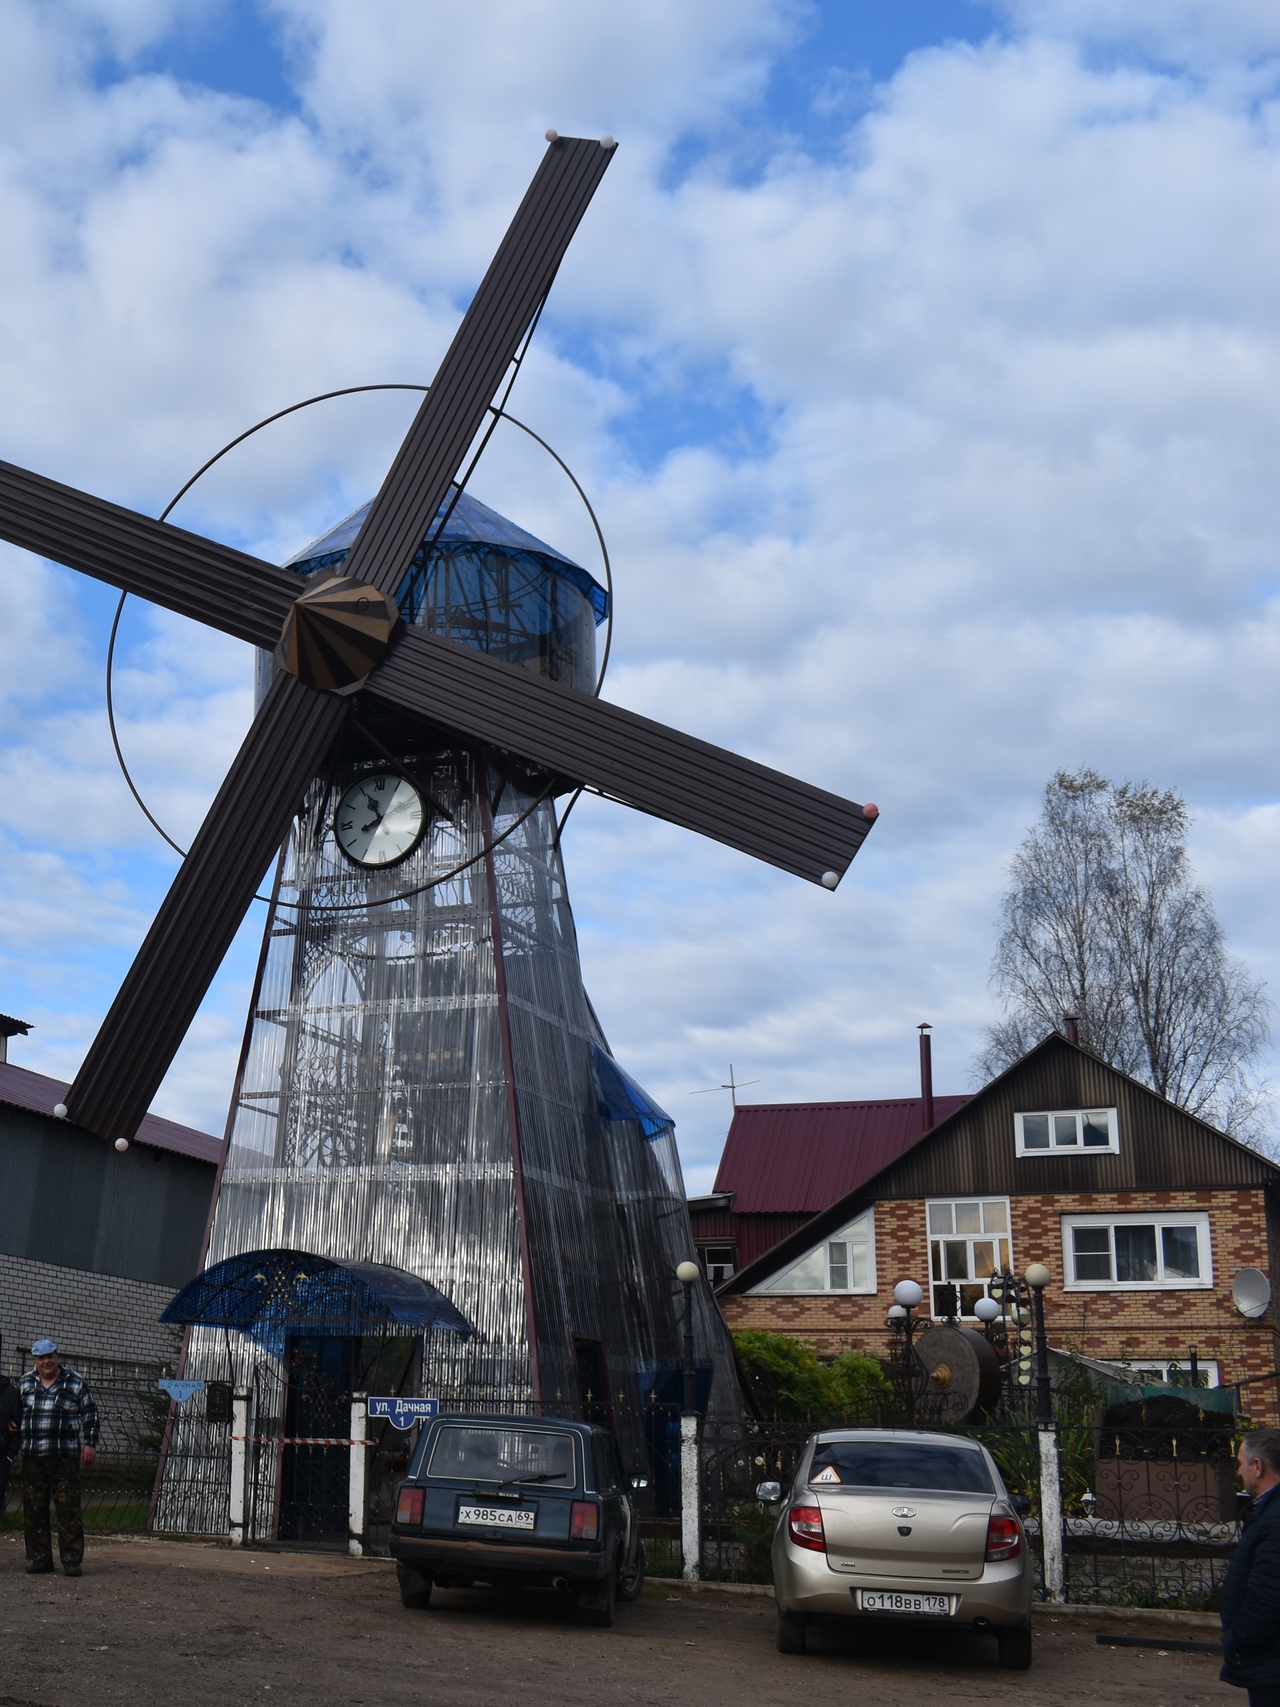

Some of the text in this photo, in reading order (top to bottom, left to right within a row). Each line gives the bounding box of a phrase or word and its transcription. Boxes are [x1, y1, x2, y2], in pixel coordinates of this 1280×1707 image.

[166, 1381, 202, 1389] ДАЧНАЯ
[375, 1400, 431, 1415] ул. Дачная
[399, 1416, 404, 1427] 1
